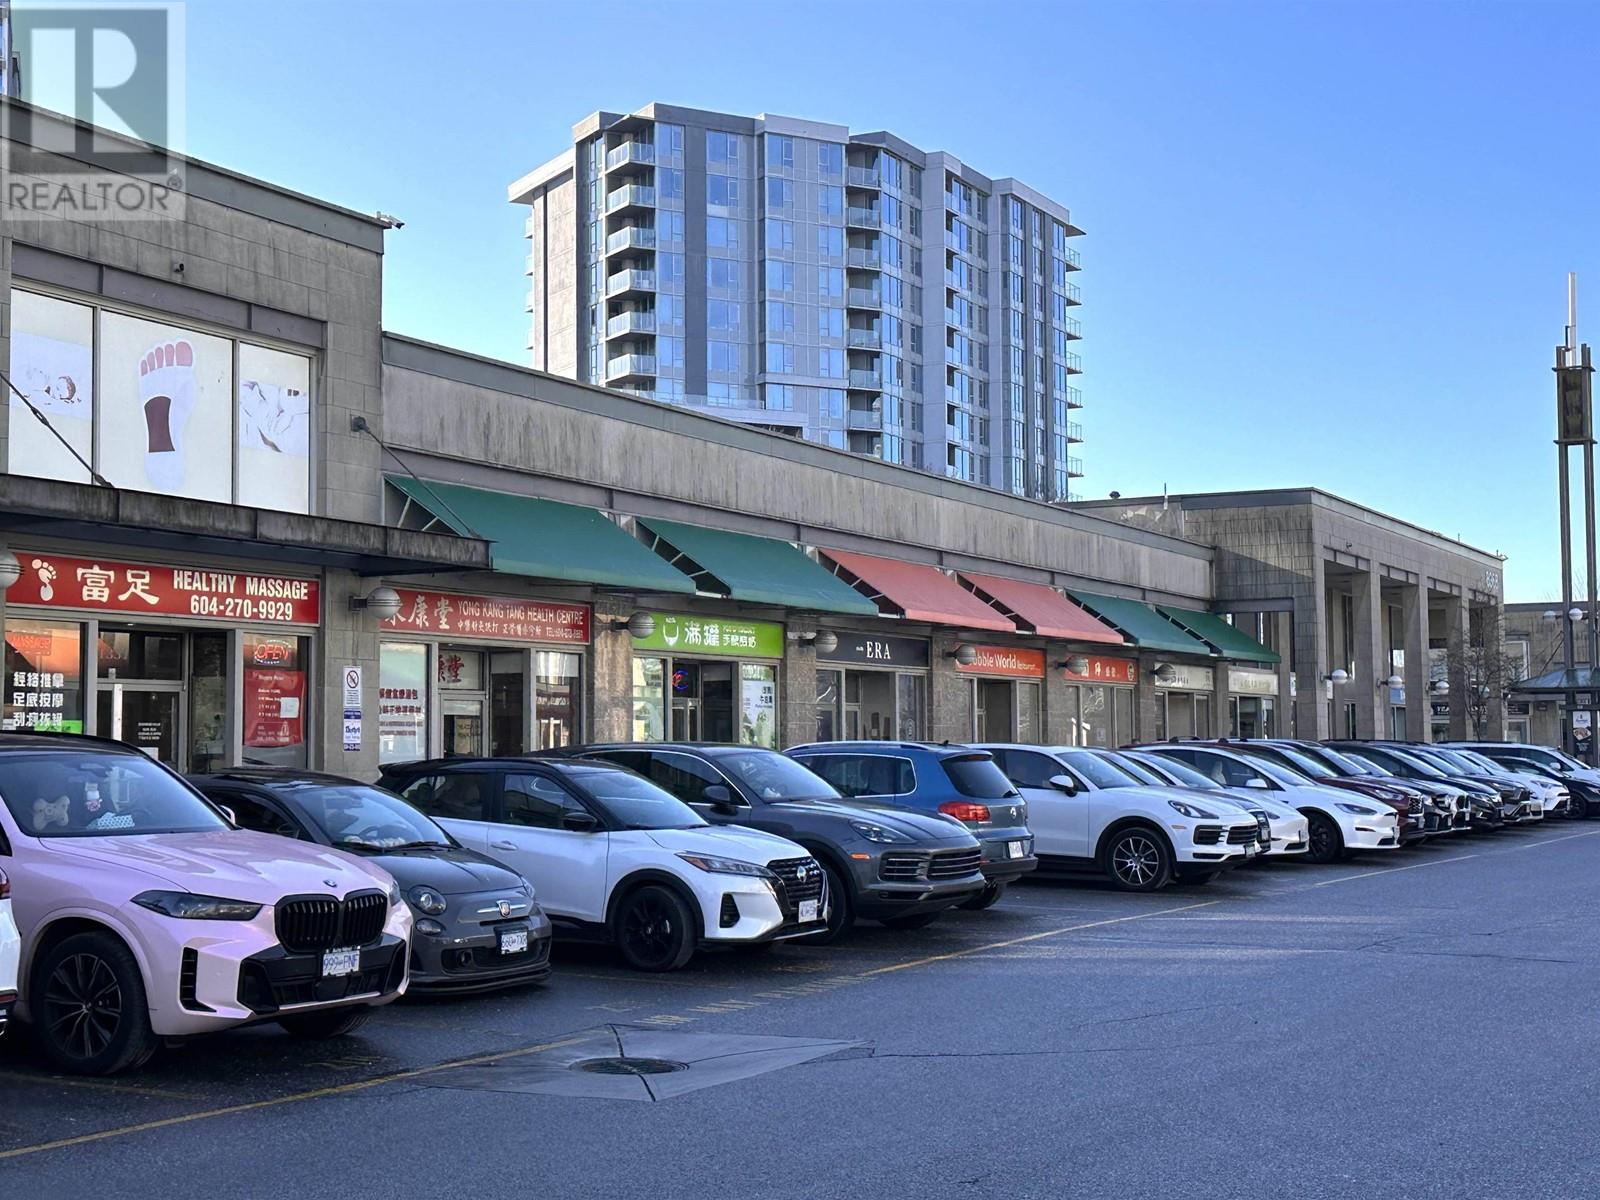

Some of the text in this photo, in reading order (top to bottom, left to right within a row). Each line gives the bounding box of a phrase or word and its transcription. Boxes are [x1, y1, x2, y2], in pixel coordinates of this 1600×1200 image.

[76, 564, 160, 605] 富足
[173, 570, 308, 601] HEALTHY MASSAGE
[190, 595, 293, 621] 604-270-9929
[457, 600, 584, 625] YONG KANG TANG HEALTH CENTRE
[254, 644, 289, 660] OPEN
[866, 641, 891, 660] ERA
[994, 653, 1017, 670] World
[13, 692, 64, 708] 足底按摩
